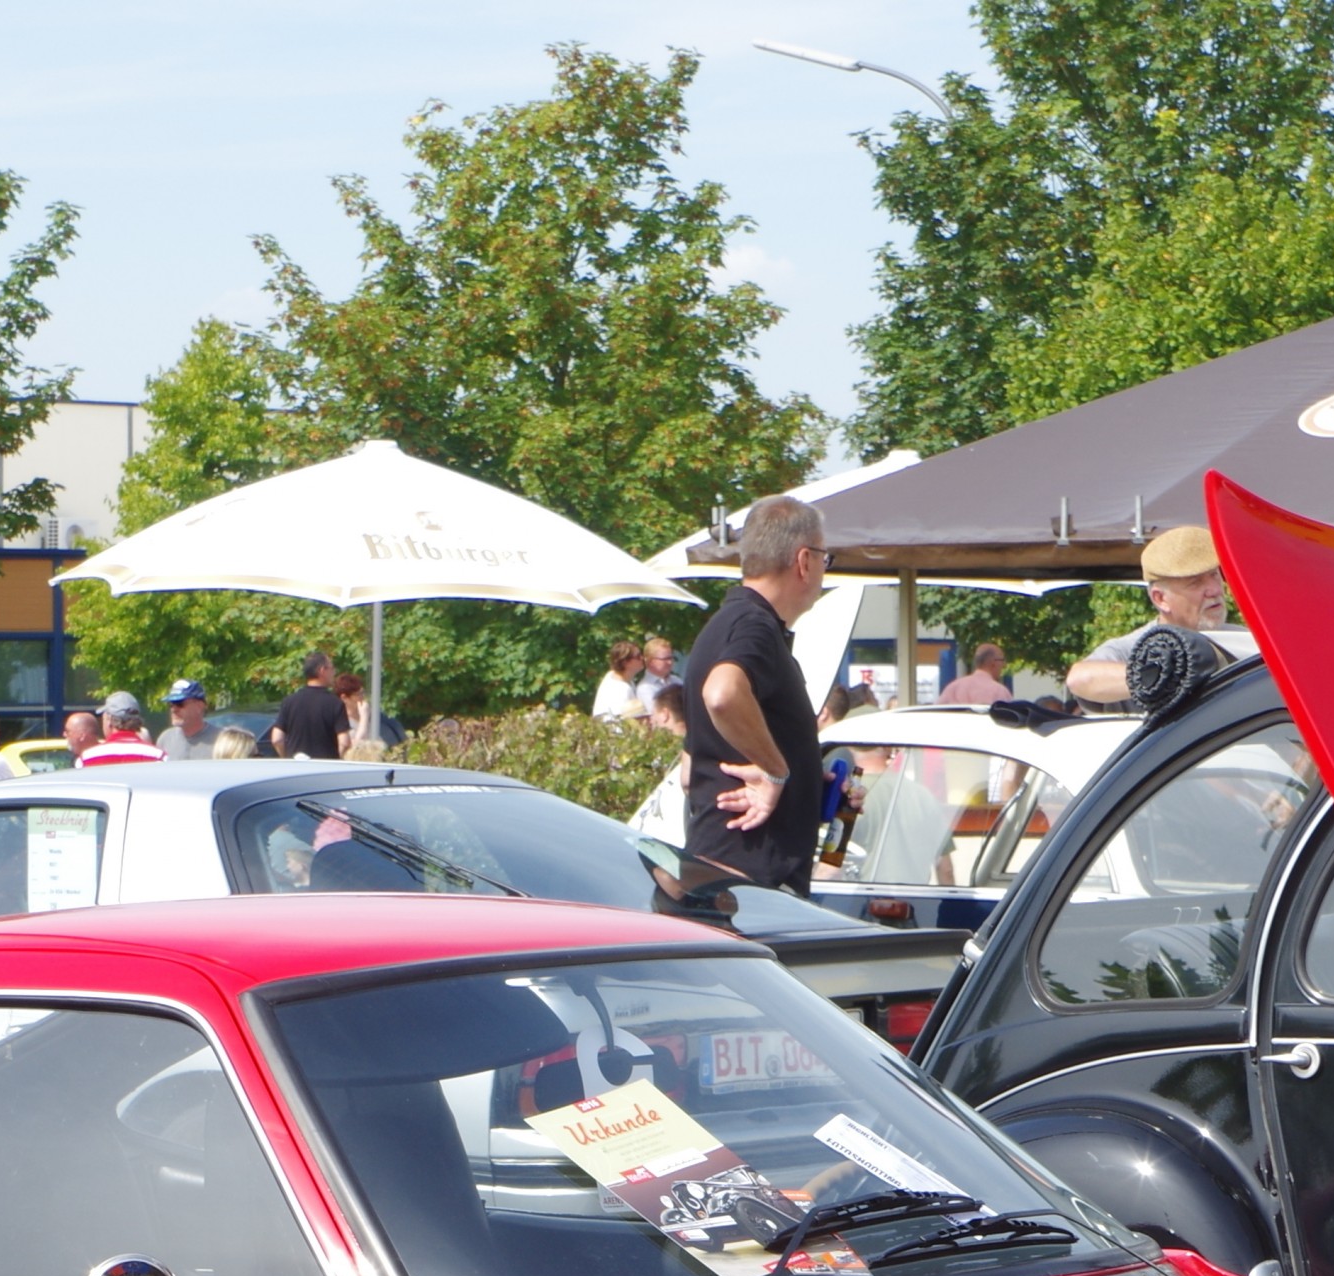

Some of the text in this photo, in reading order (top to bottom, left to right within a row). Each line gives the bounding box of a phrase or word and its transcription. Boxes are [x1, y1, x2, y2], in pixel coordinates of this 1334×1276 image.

[362, 532, 529, 567] Bitburger
[36, 807, 91, 832] Steckbrief
[713, 1036, 763, 1077] BIT
[563, 1103, 664, 1146] Urkunde
